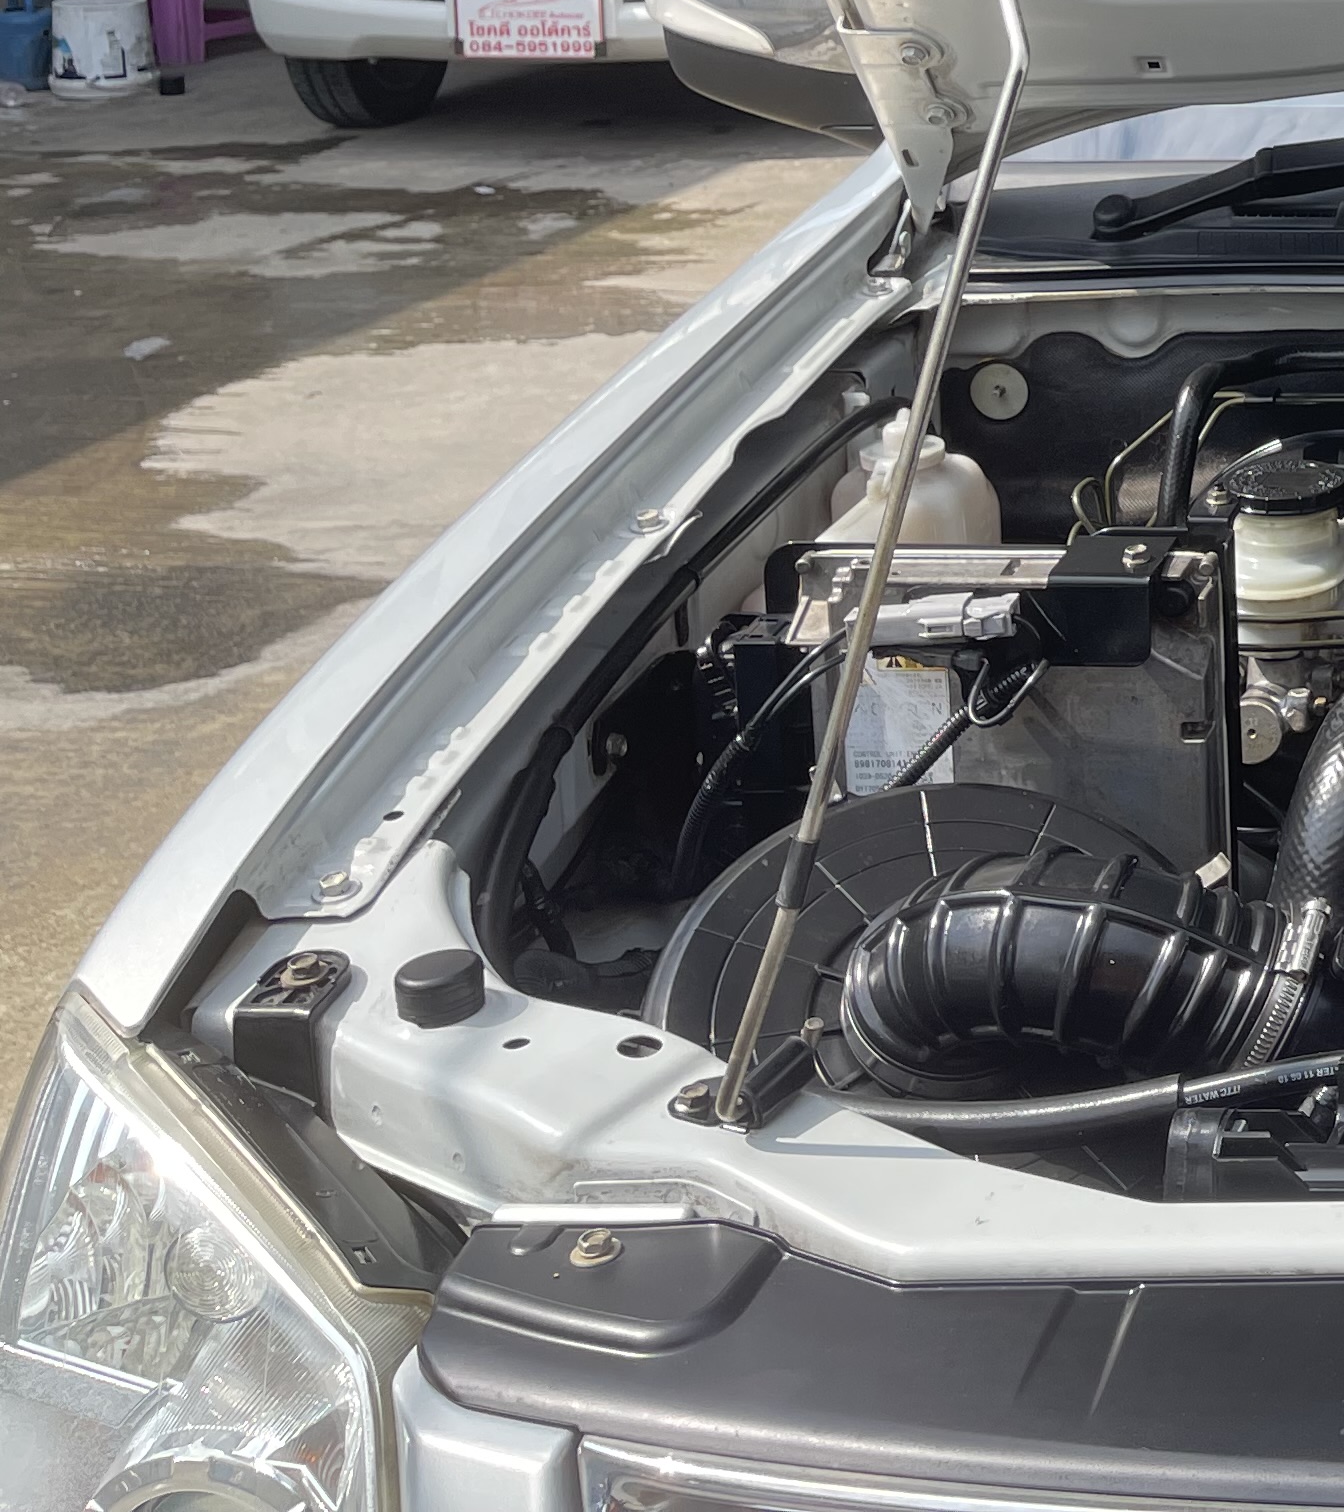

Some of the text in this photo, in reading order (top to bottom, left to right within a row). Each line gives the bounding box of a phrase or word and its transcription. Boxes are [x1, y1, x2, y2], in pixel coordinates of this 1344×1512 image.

[468, 19, 592, 38] โชคดี ออโต้คาร์
[1184, 1087, 1219, 1105] WATER
